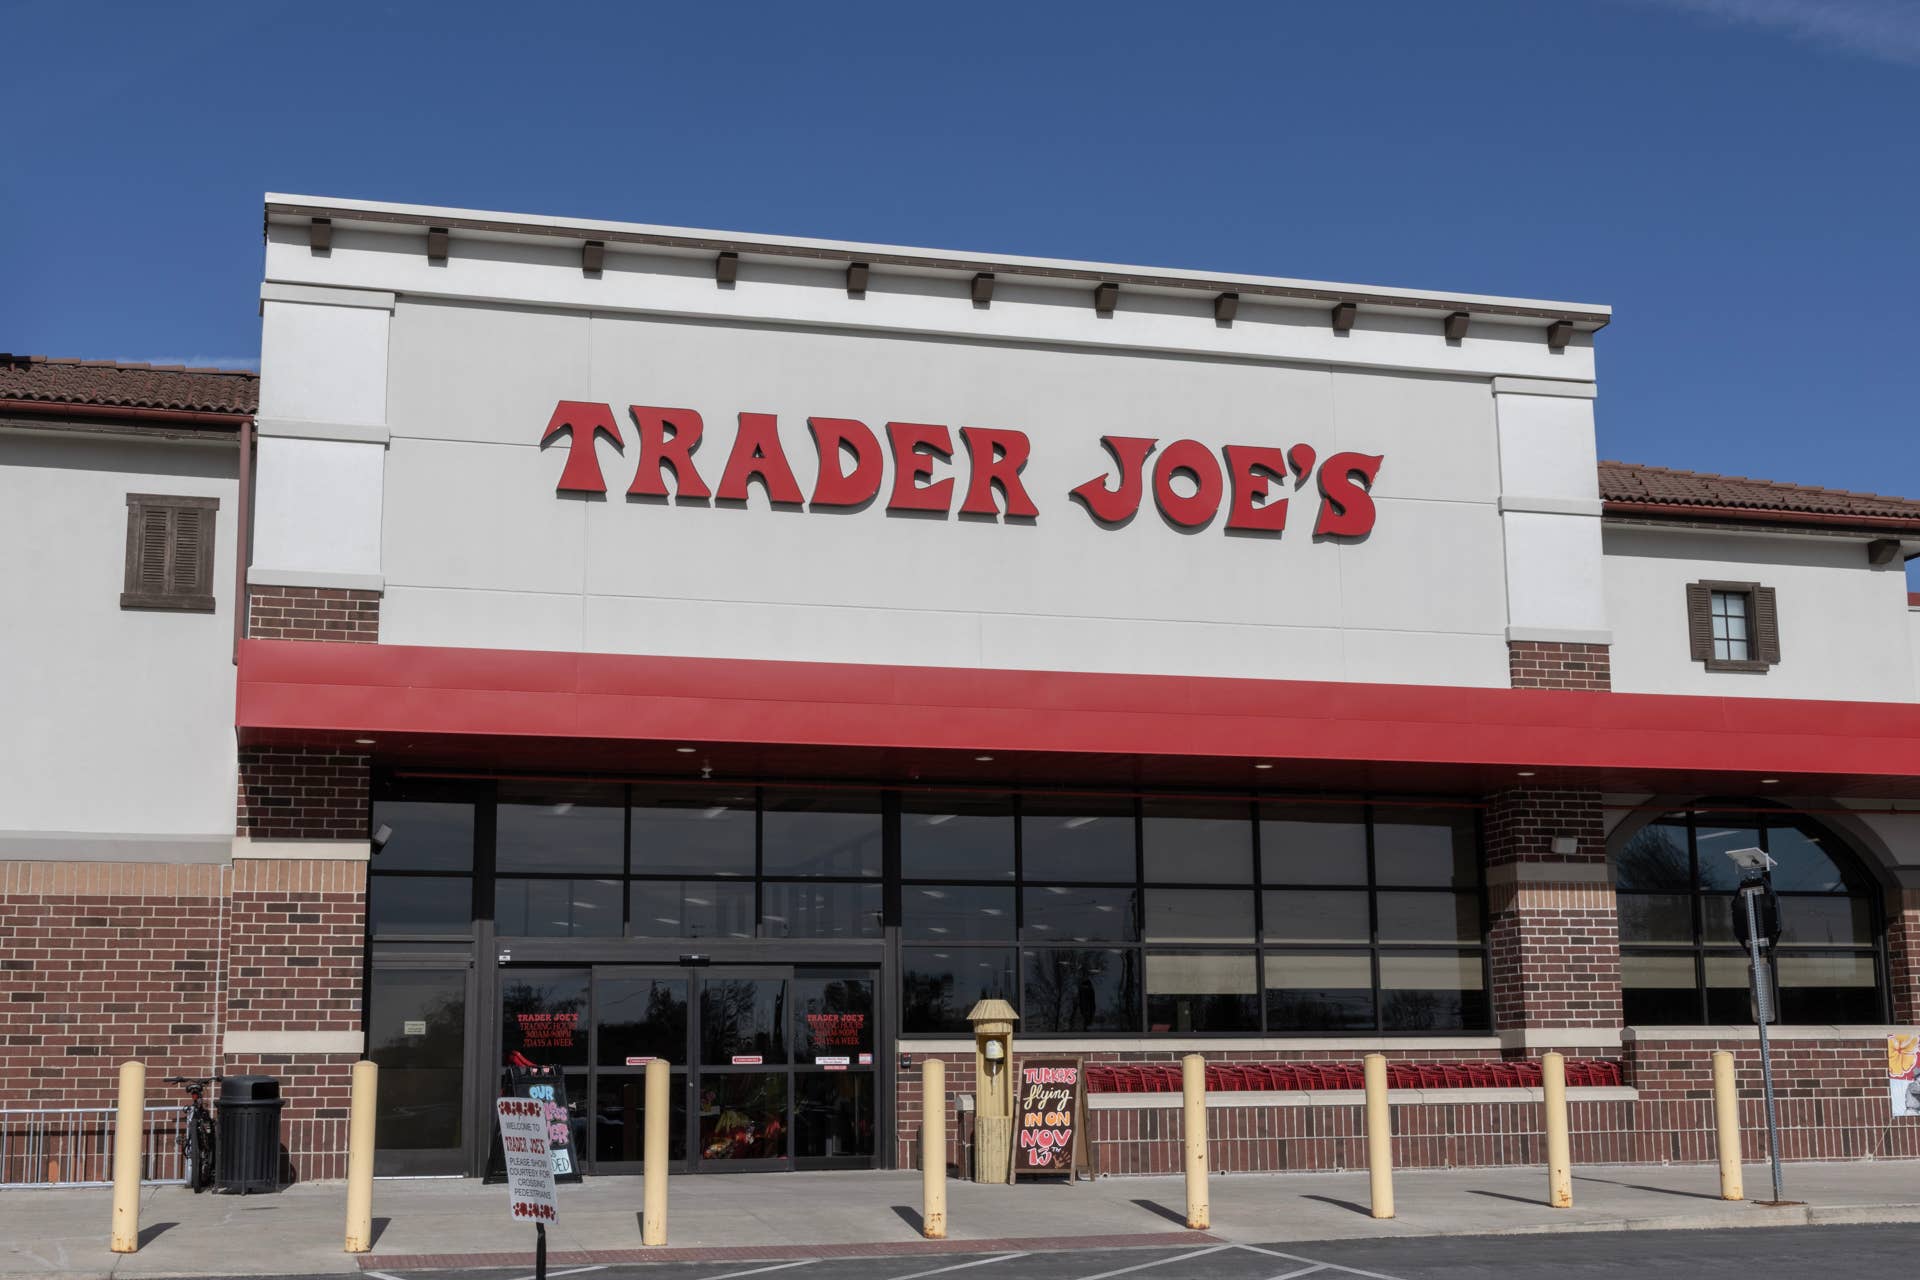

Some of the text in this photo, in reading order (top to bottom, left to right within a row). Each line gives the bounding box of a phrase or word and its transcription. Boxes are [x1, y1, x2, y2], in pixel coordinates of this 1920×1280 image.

[540, 400, 1384, 544] TRADER JOE'S
[517, 1013, 551, 1021] TRADER
[1023, 1067, 1077, 1084] TURKEYS
[529, 1085, 555, 1100] OUR
[1023, 1084, 1073, 1111] flying
[506, 1121, 540, 1132] WELCOME TO
[1024, 1111, 1070, 1127] IN ON
[505, 1135, 528, 1152] TRADER
[1021, 1129, 1072, 1148] NOV
[509, 1157, 530, 1167] PLEASE
[509, 1167, 538, 1178] COURTESY
[517, 1178, 546, 1188] CROSSING
[514, 1187, 552, 1199] PEDESTRIANS
